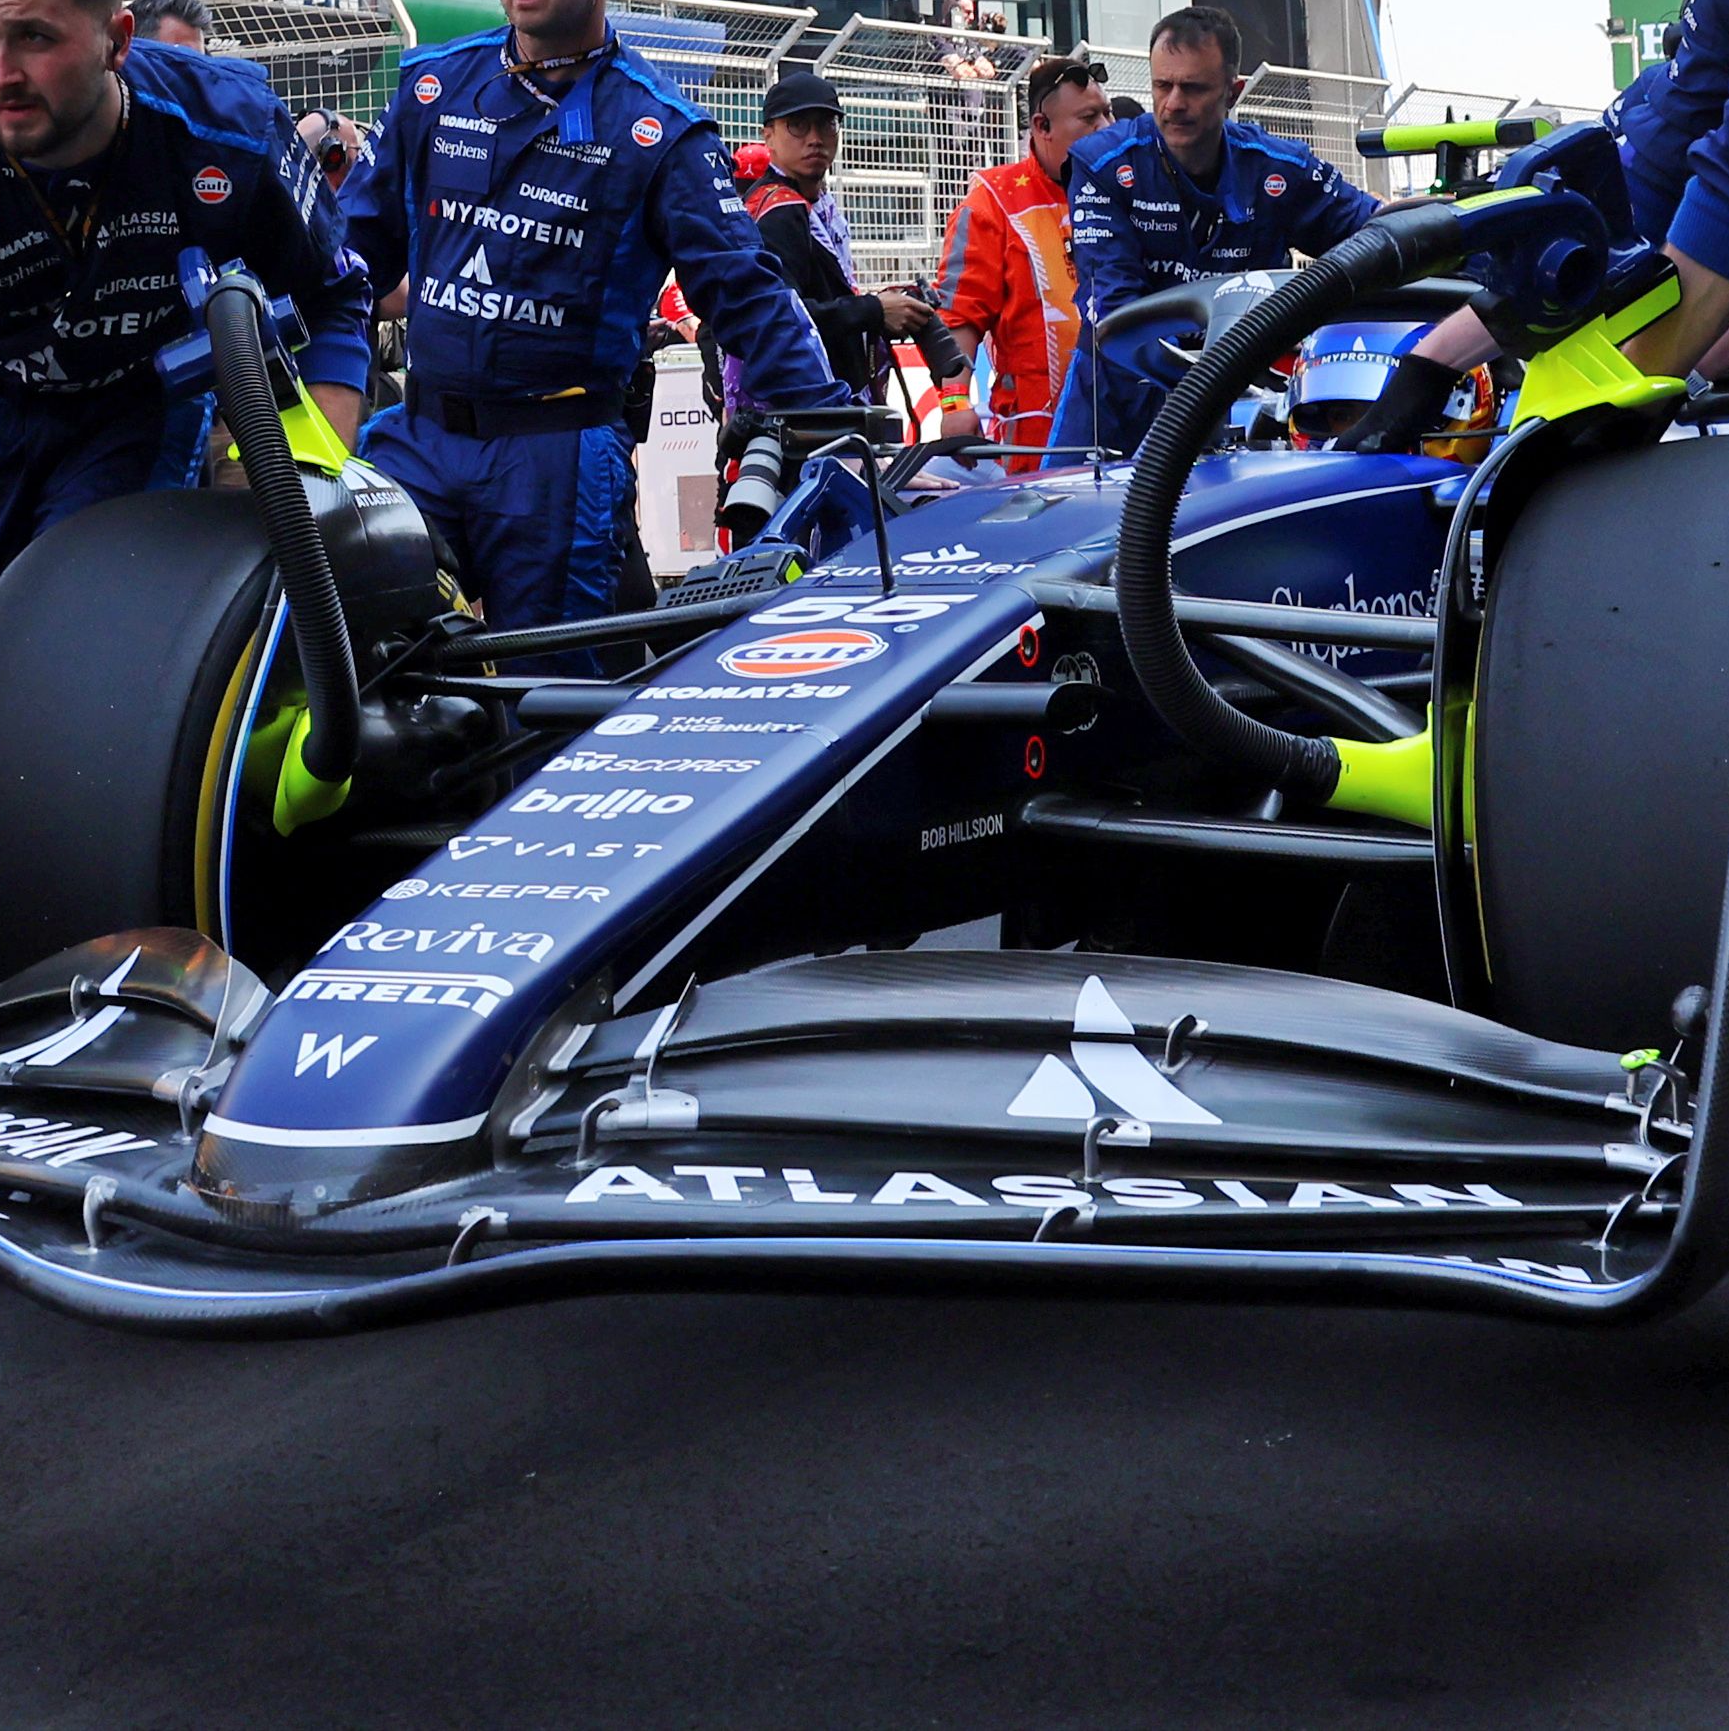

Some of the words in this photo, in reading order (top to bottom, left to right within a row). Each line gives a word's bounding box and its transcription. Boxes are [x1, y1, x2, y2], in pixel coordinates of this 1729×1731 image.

[415, 81, 441, 97] Gulf
[439, 114, 497, 135] KOMATSU
[633, 123, 660, 139] Gulf
[433, 136, 489, 162] Stephens
[194, 177, 231, 194] Gulf
[519, 182, 589, 212] DURACELL
[1132, 199, 1181, 213] KOMATSU
[1130, 214, 1178, 232] Stephens
[1321, 350, 1401, 369] MYPROTEIN
[803, 561, 1037, 578] Santander
[748, 594, 978, 625] 55
[732, 644, 875, 662] Gulf
[635, 682, 851, 700] KOMATSU
[670, 716, 724, 725] THG
[921, 828, 947, 851] BOB
[949, 813, 1004, 848] HILLSDON
[511, 842, 663, 859] VAST
[426, 882, 611, 903] KEEPER
[317, 921, 556, 964] Reviva
[275, 969, 515, 1019] PIRELLI
[563, 1163, 1524, 1213] ATLASSIAN
